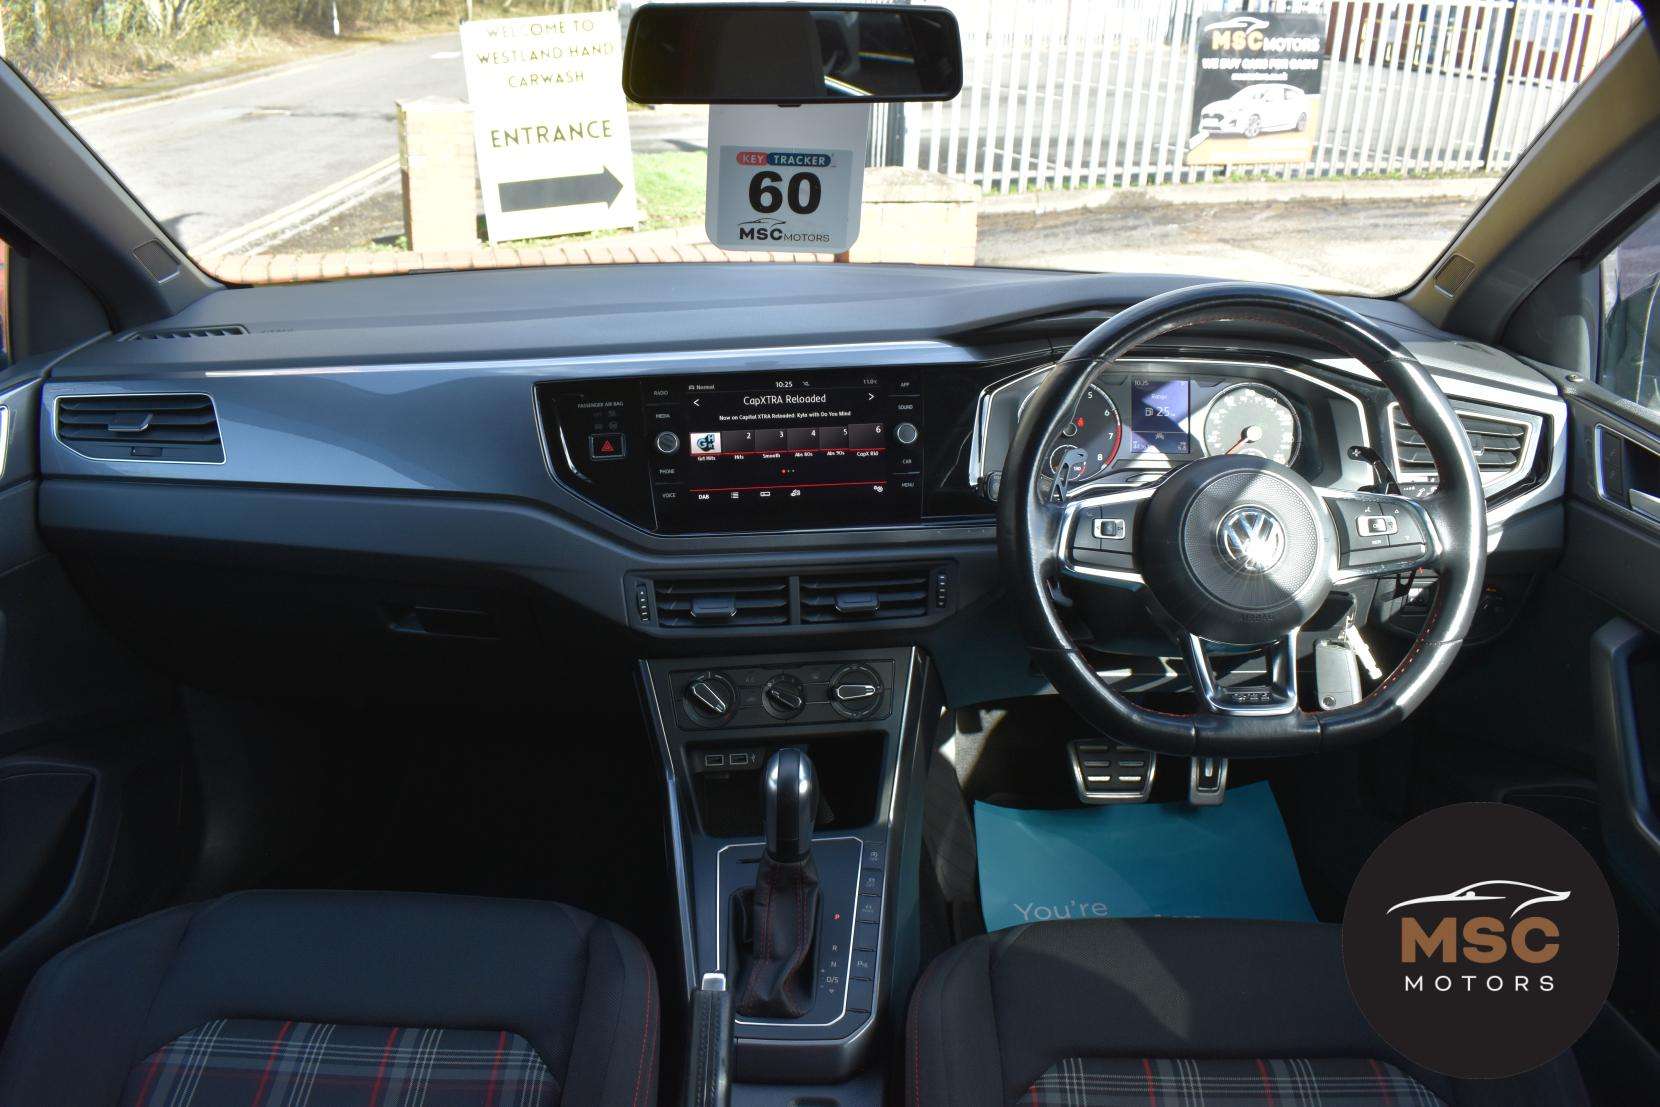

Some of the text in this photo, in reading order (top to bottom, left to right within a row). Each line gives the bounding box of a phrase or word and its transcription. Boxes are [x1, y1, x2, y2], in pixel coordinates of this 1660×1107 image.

[573, 18, 594, 33] TO
[1211, 30, 1321, 53] MSC MOTORS
[476, 42, 614, 66] WESTLAND HAND
[508, 71, 584, 88] CARWASH
[490, 119, 613, 148] ENTRANCE
[742, 154, 826, 166] KEY TRACKER
[748, 170, 822, 215] 60
[739, 227, 830, 243] MSC MOTORS
[743, 394, 827, 406] CapXTRA Reloaded
[1087, 391, 1093, 399] 5
[1108, 432, 1114, 440] 7
[1097, 453, 1103, 461] 8
[1013, 899, 1109, 921] You're
